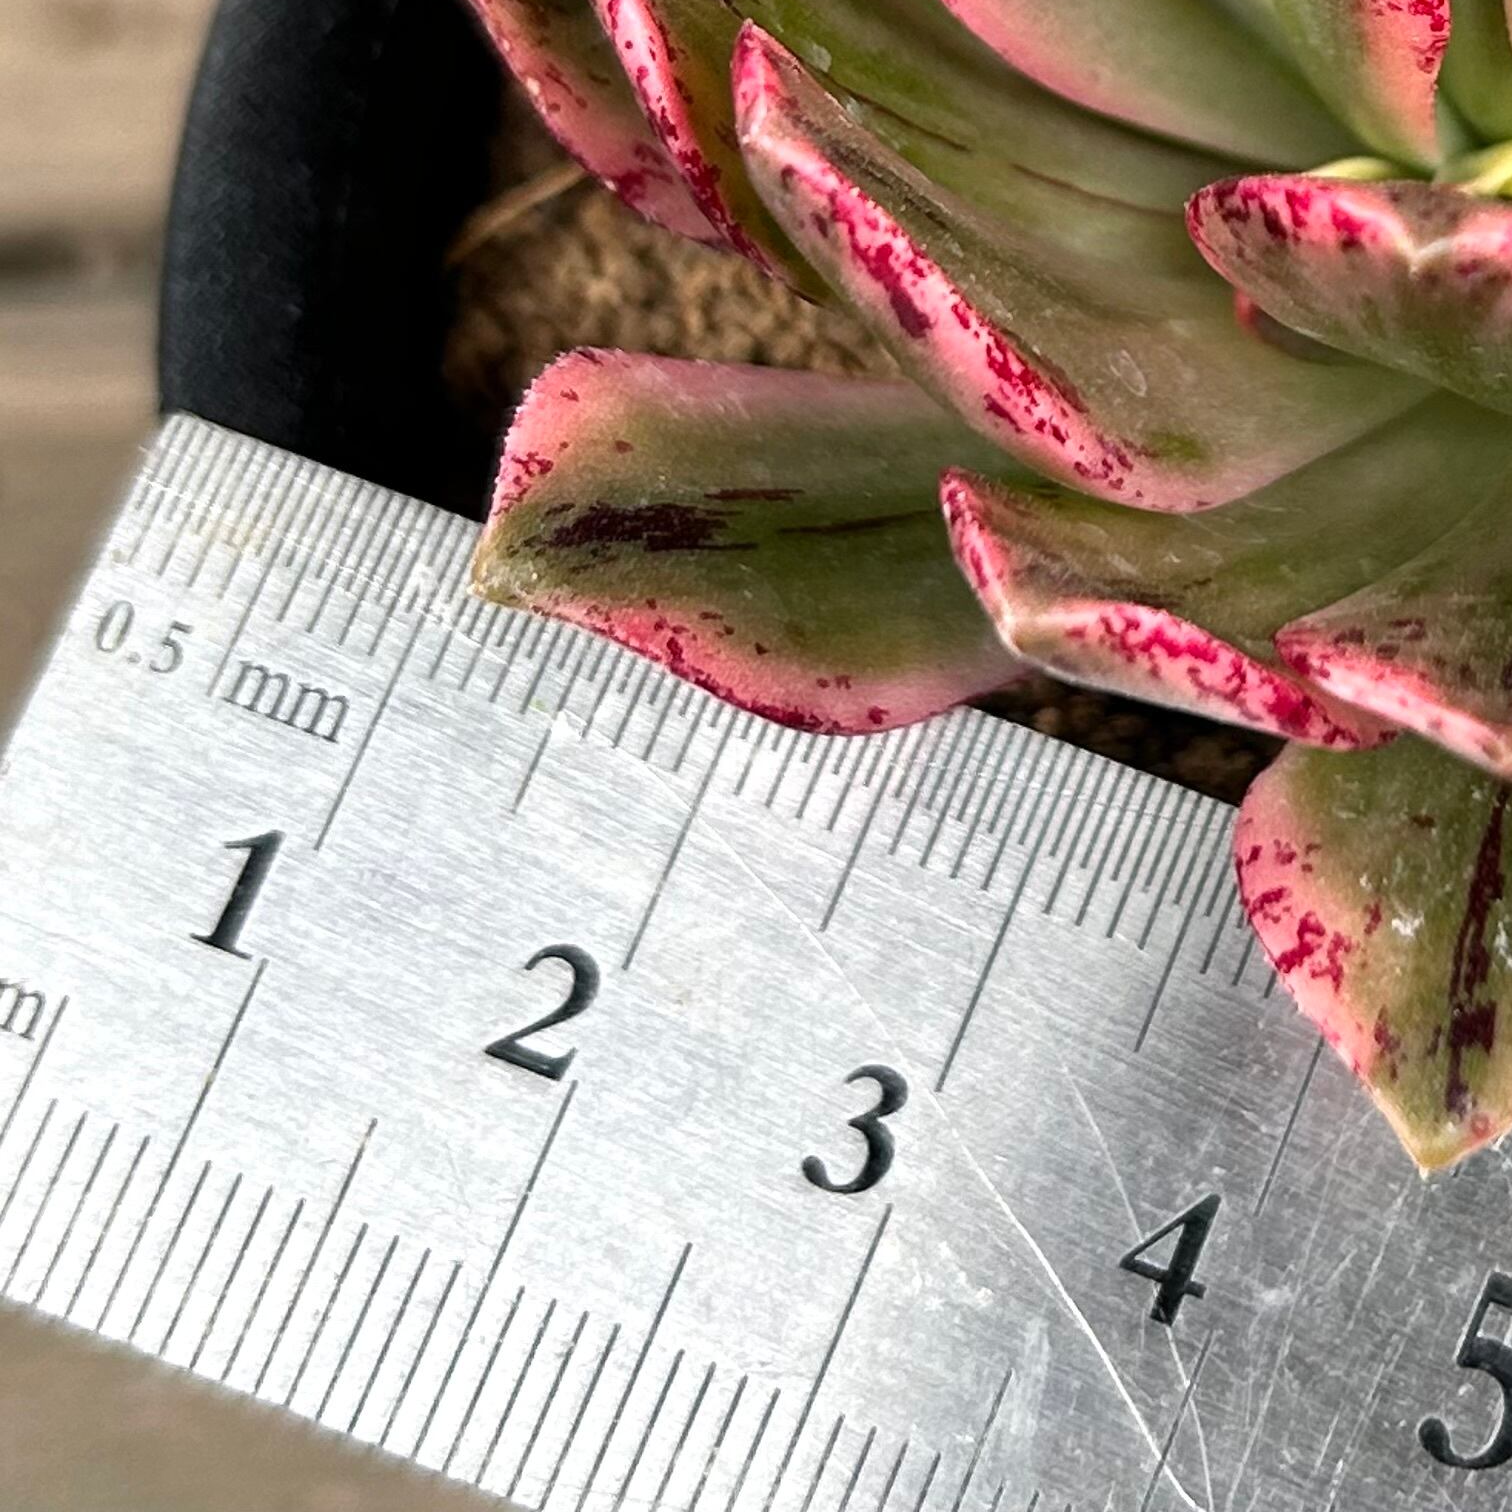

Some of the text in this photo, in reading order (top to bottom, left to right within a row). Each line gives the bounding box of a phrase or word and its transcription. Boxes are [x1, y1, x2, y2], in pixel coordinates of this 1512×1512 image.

[95, 599, 350, 744] 0.5 mm
[190, 829, 284, 960] 1
[485, 943, 602, 1081] 2
[801, 1064, 909, 1194] 3
[1119, 1192, 1221, 1327] 4
